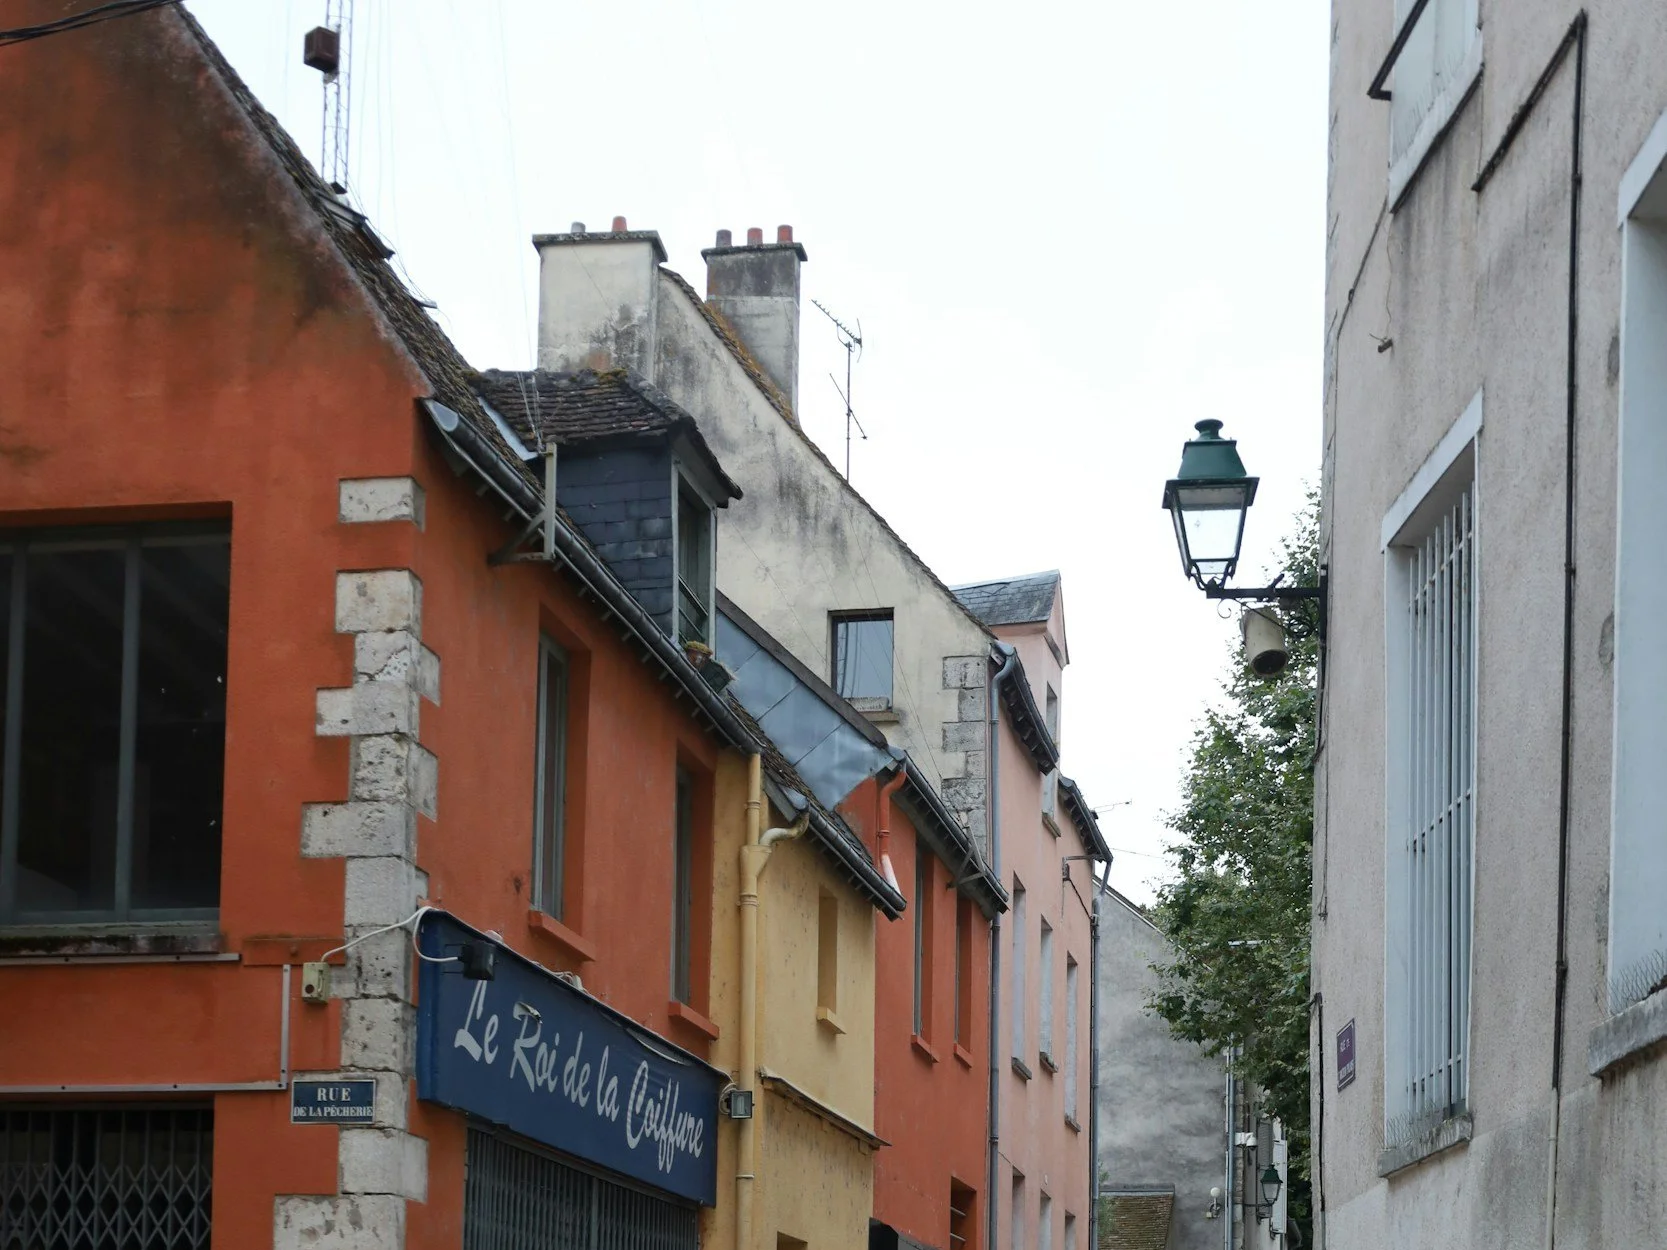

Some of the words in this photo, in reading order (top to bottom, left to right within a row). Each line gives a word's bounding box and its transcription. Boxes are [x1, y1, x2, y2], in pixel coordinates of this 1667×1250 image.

[454, 980, 498, 1064] Le
[510, 1001, 560, 1092] Roi
[563, 1031, 591, 1107] de
[597, 1045, 620, 1122] la
[626, 1060, 704, 1174] Coiffure
[317, 1087, 352, 1102] RUE
[293, 1106, 307, 1117] DE
[309, 1106, 322, 1117] LA
[323, 1105, 373, 1117] PÊCHERIE
